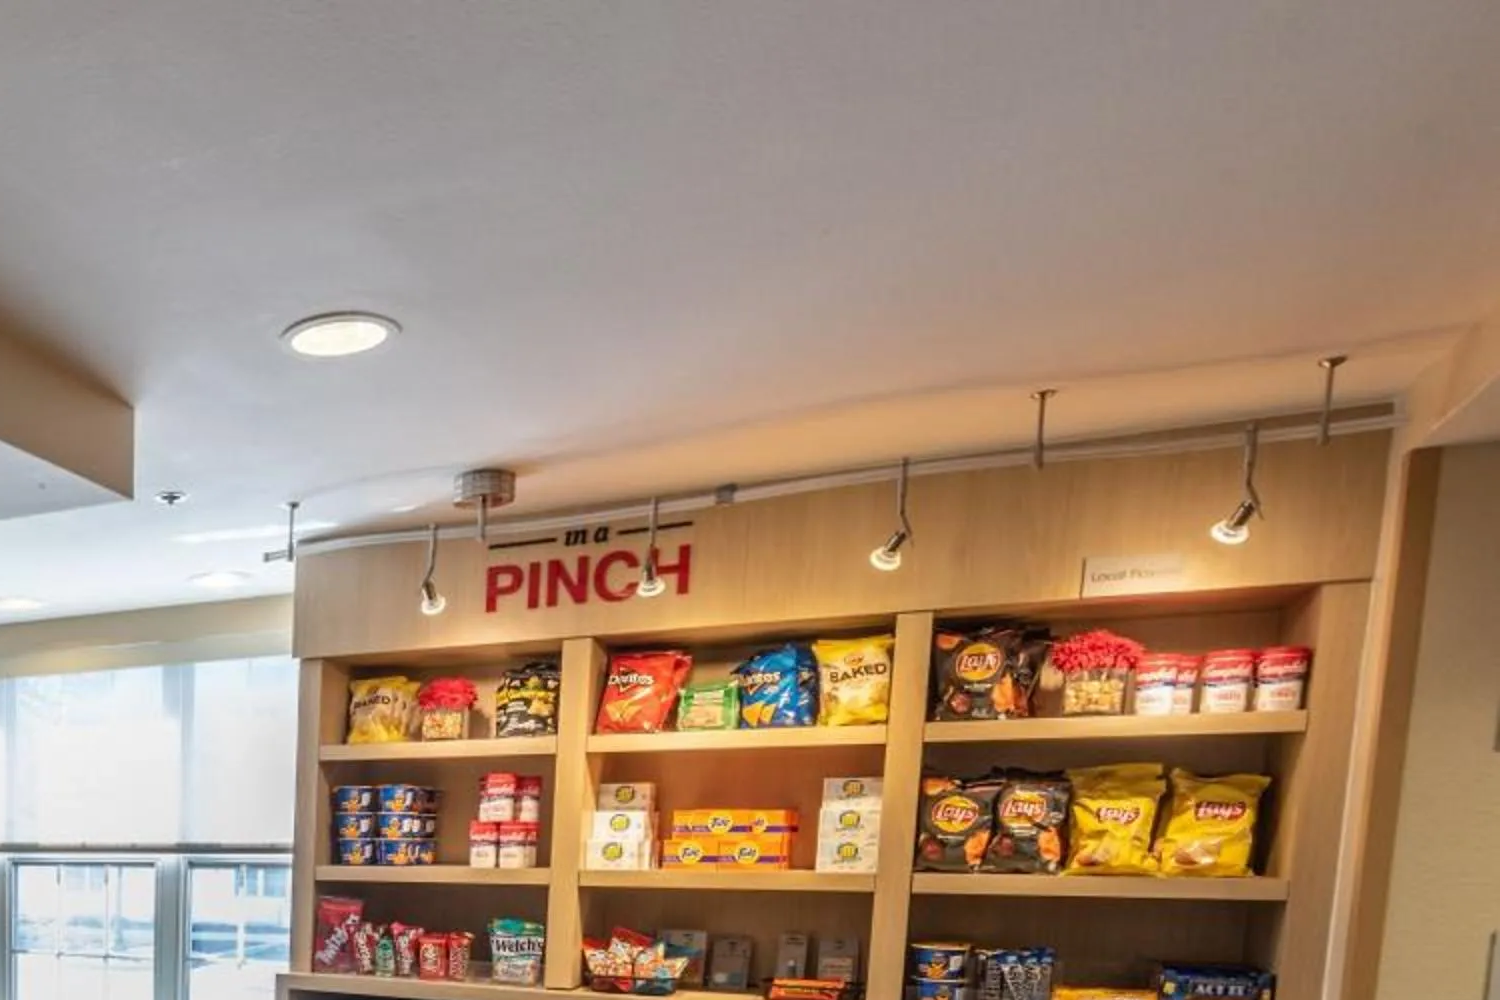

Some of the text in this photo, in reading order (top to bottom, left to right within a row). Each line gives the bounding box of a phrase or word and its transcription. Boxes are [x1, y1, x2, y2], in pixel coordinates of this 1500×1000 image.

[564, 526, 609, 546] in a
[485, 544, 691, 613] PINCH
[830, 662, 887, 683] BAKED
